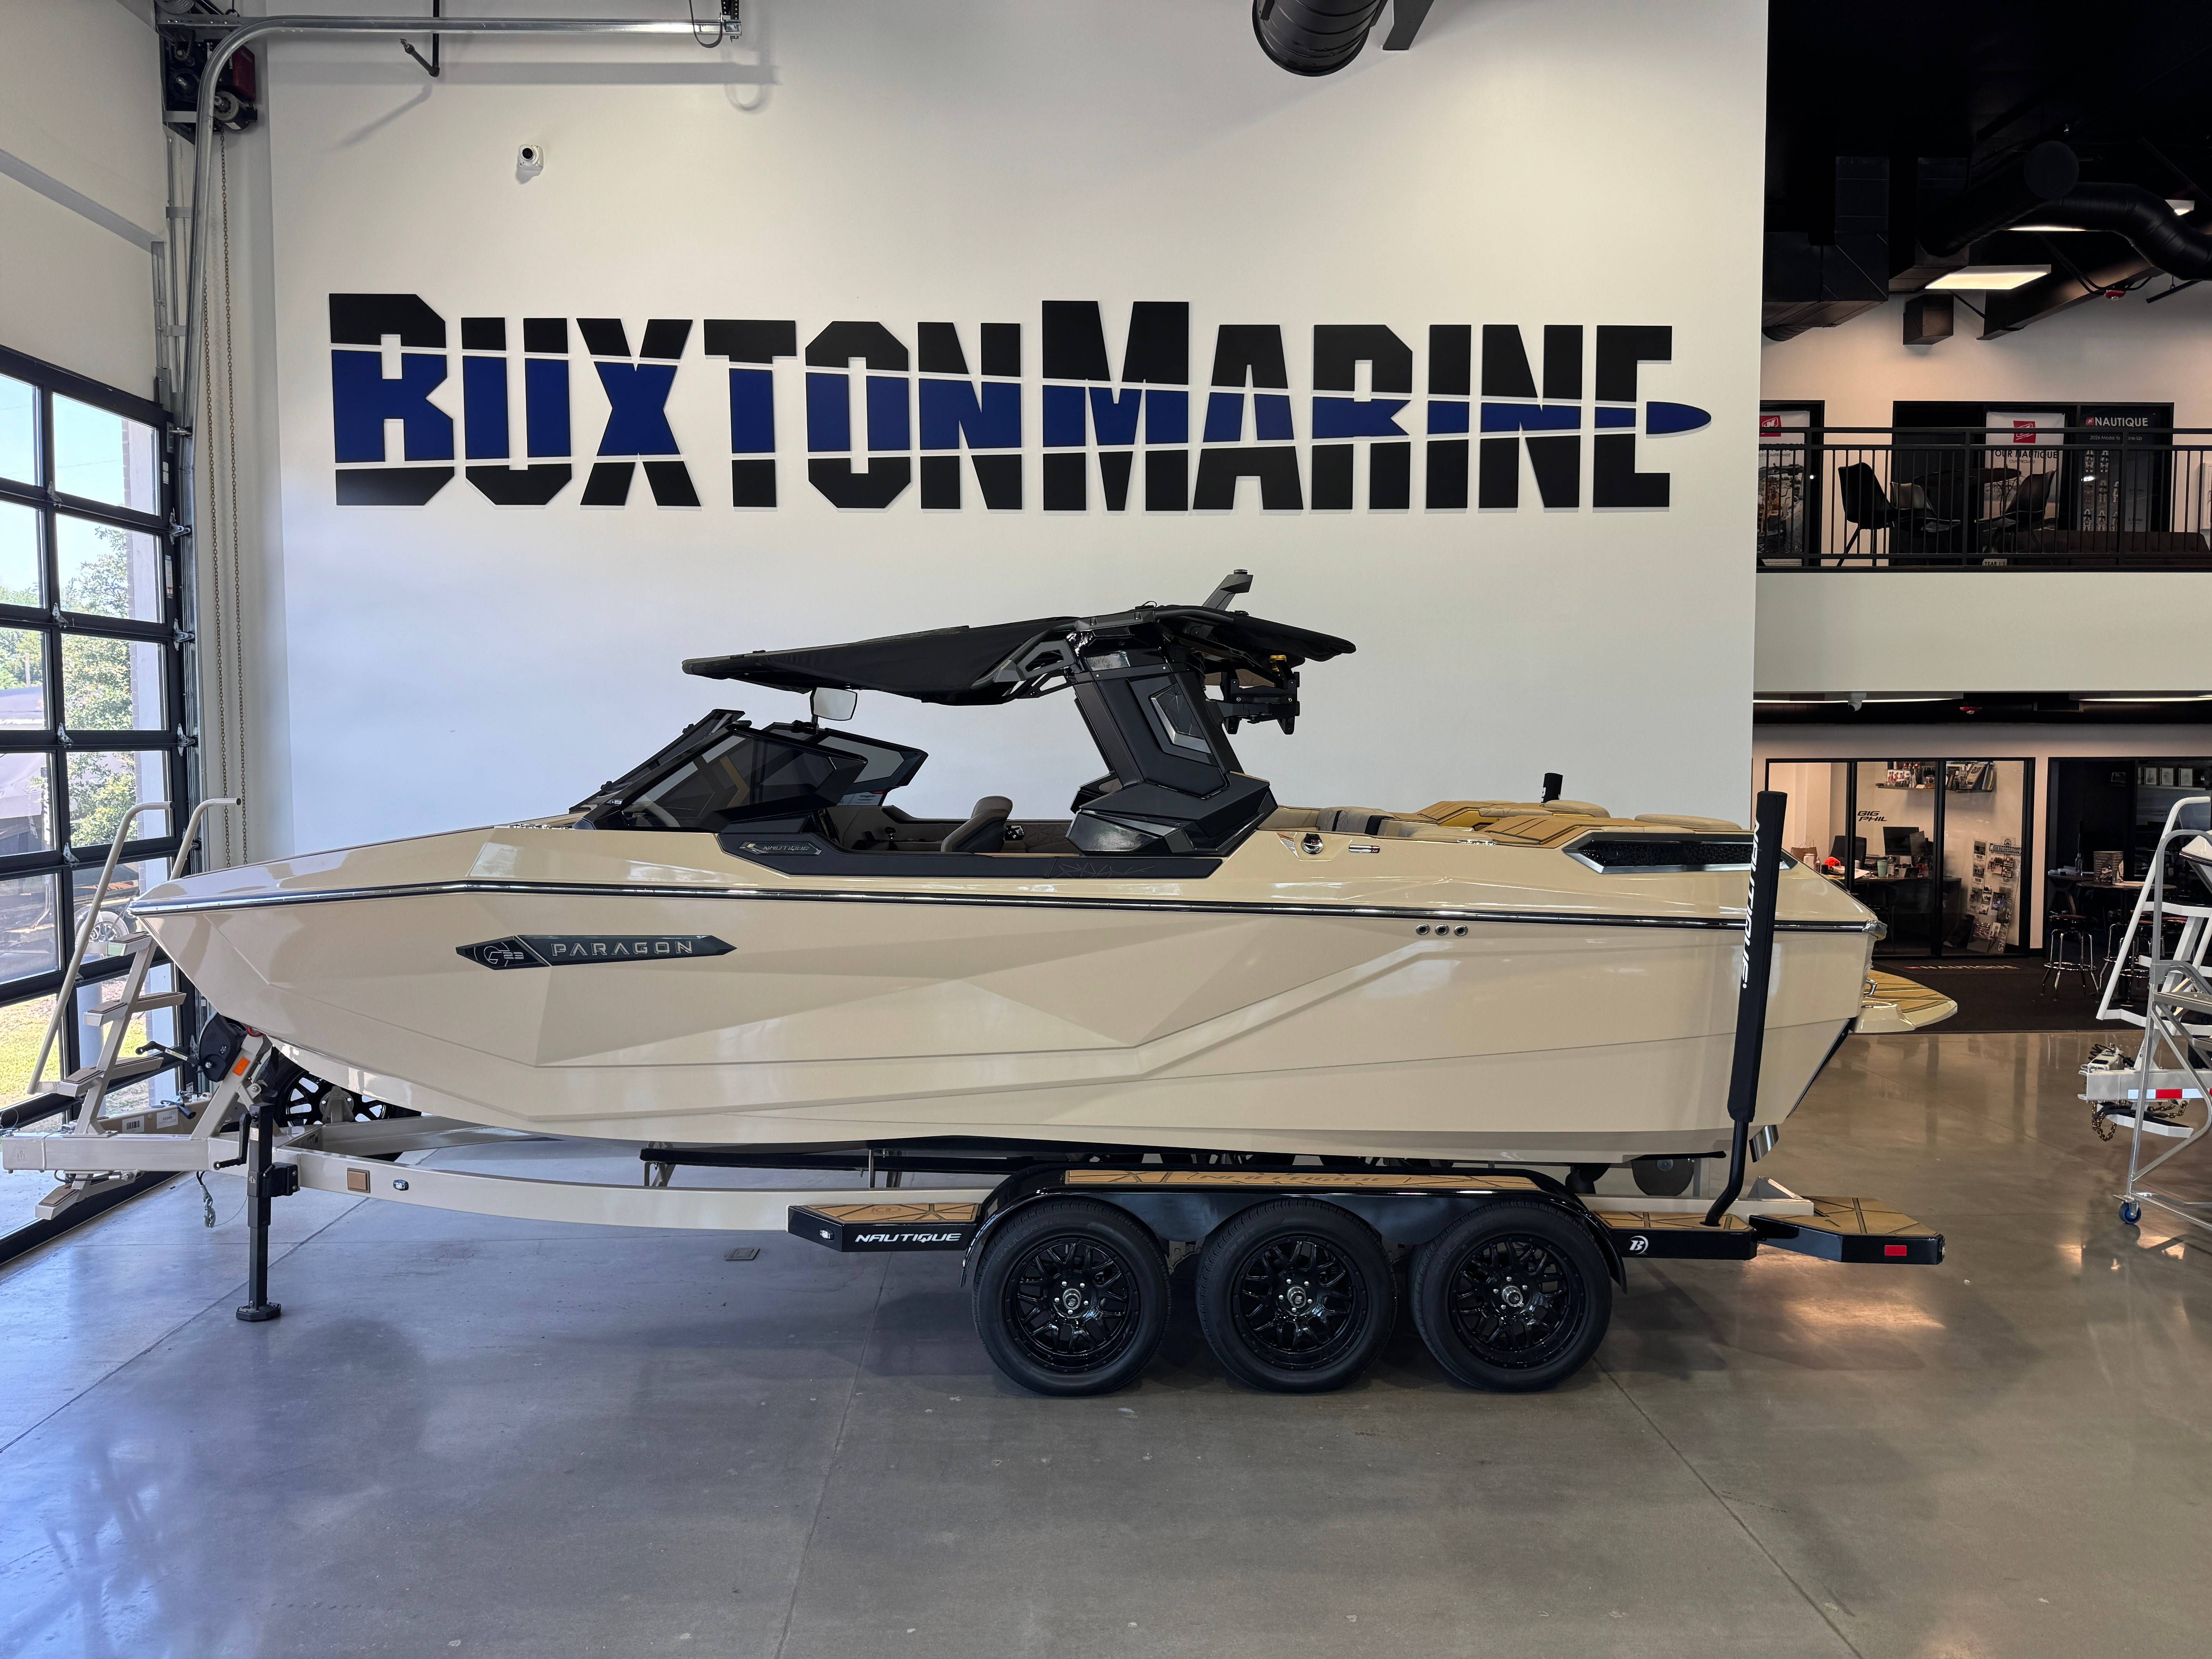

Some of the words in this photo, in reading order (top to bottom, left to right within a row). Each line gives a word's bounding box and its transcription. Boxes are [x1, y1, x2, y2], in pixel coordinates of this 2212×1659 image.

[2095, 417, 2148, 427] NAUTIQUE
[1998, 923, 2009, 952] YEARS
[551, 940, 693, 957] PARAGON
[855, 1233, 962, 1243] NAUTIQUE
[996, 1224, 1039, 1262] HAULER
